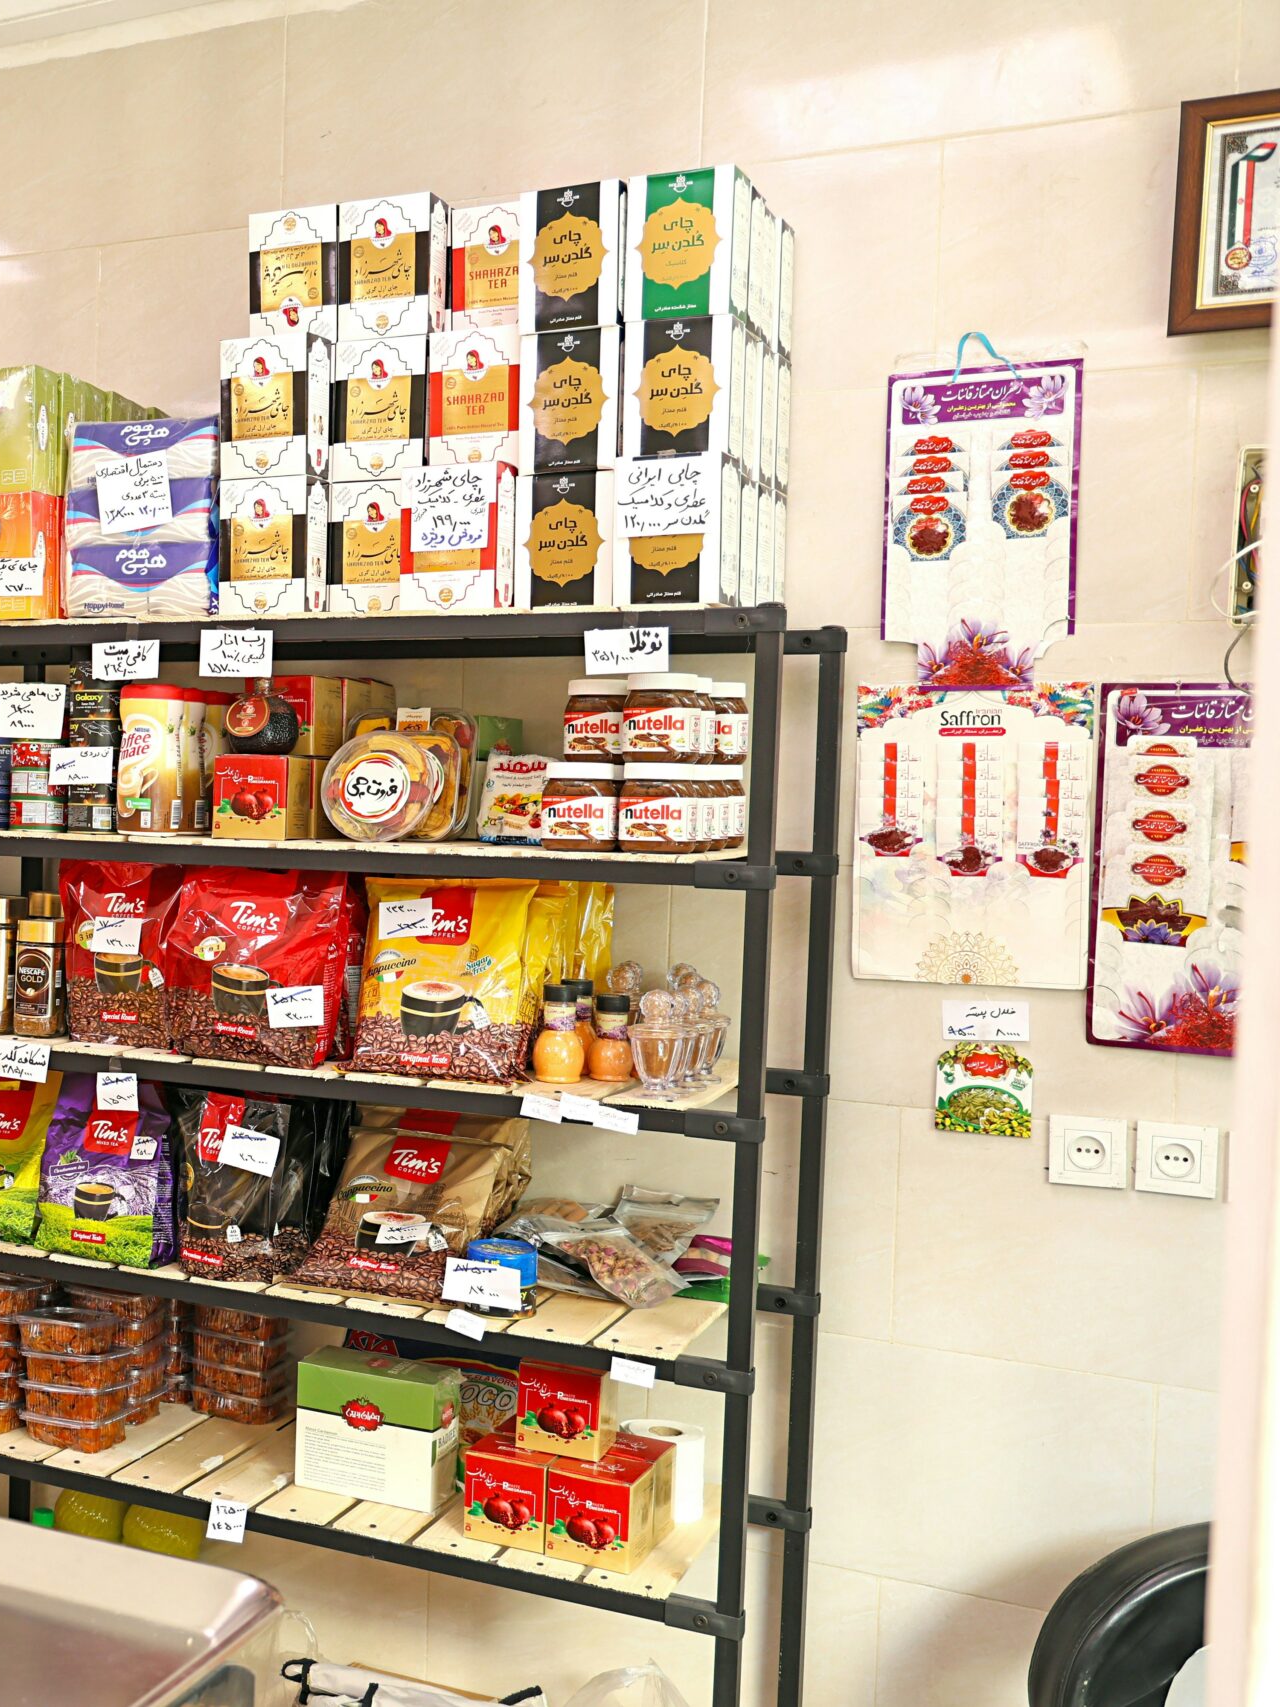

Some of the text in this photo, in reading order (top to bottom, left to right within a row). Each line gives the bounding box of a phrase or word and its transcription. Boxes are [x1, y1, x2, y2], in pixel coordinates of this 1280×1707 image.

[469, 265, 519, 281] SHAHRZA
[488, 278, 507, 289] TEA
[446, 391, 505, 406] SHAHRZAD
[465, 406, 486, 416] TEA
[211, 634, 265, 650] رب انار
[630, 630, 662, 655] نوتلا
[104, 642, 154, 666] کافی میت
[75, 694, 103, 703] Galaxy
[628, 715, 684, 731] nutella
[940, 711, 1001, 726] Saffron
[548, 804, 604, 819] nutella
[625, 805, 682, 820] nutella
[104, 893, 145, 913] Tim's
[230, 901, 280, 931] Tim's
[237, 924, 265, 934] COFFEE
[466, 955, 492, 971] Sugar
[472, 964, 488, 977] Free
[19, 966, 46, 976] NESCAFÉ
[20, 973, 43, 983] GOLD
[101, 1012, 120, 1021] Special
[215, 1022, 255, 1036] Special Roast
[401, 1054, 449, 1065] Original Taste
[92, 1120, 128, 1142] Tim's
[392, 1149, 441, 1174] Tim's
[397, 1167, 426, 1177] COFFEE
[337, 1183, 393, 1200] Cappuccino
[349, 1258, 374, 1270] Original
